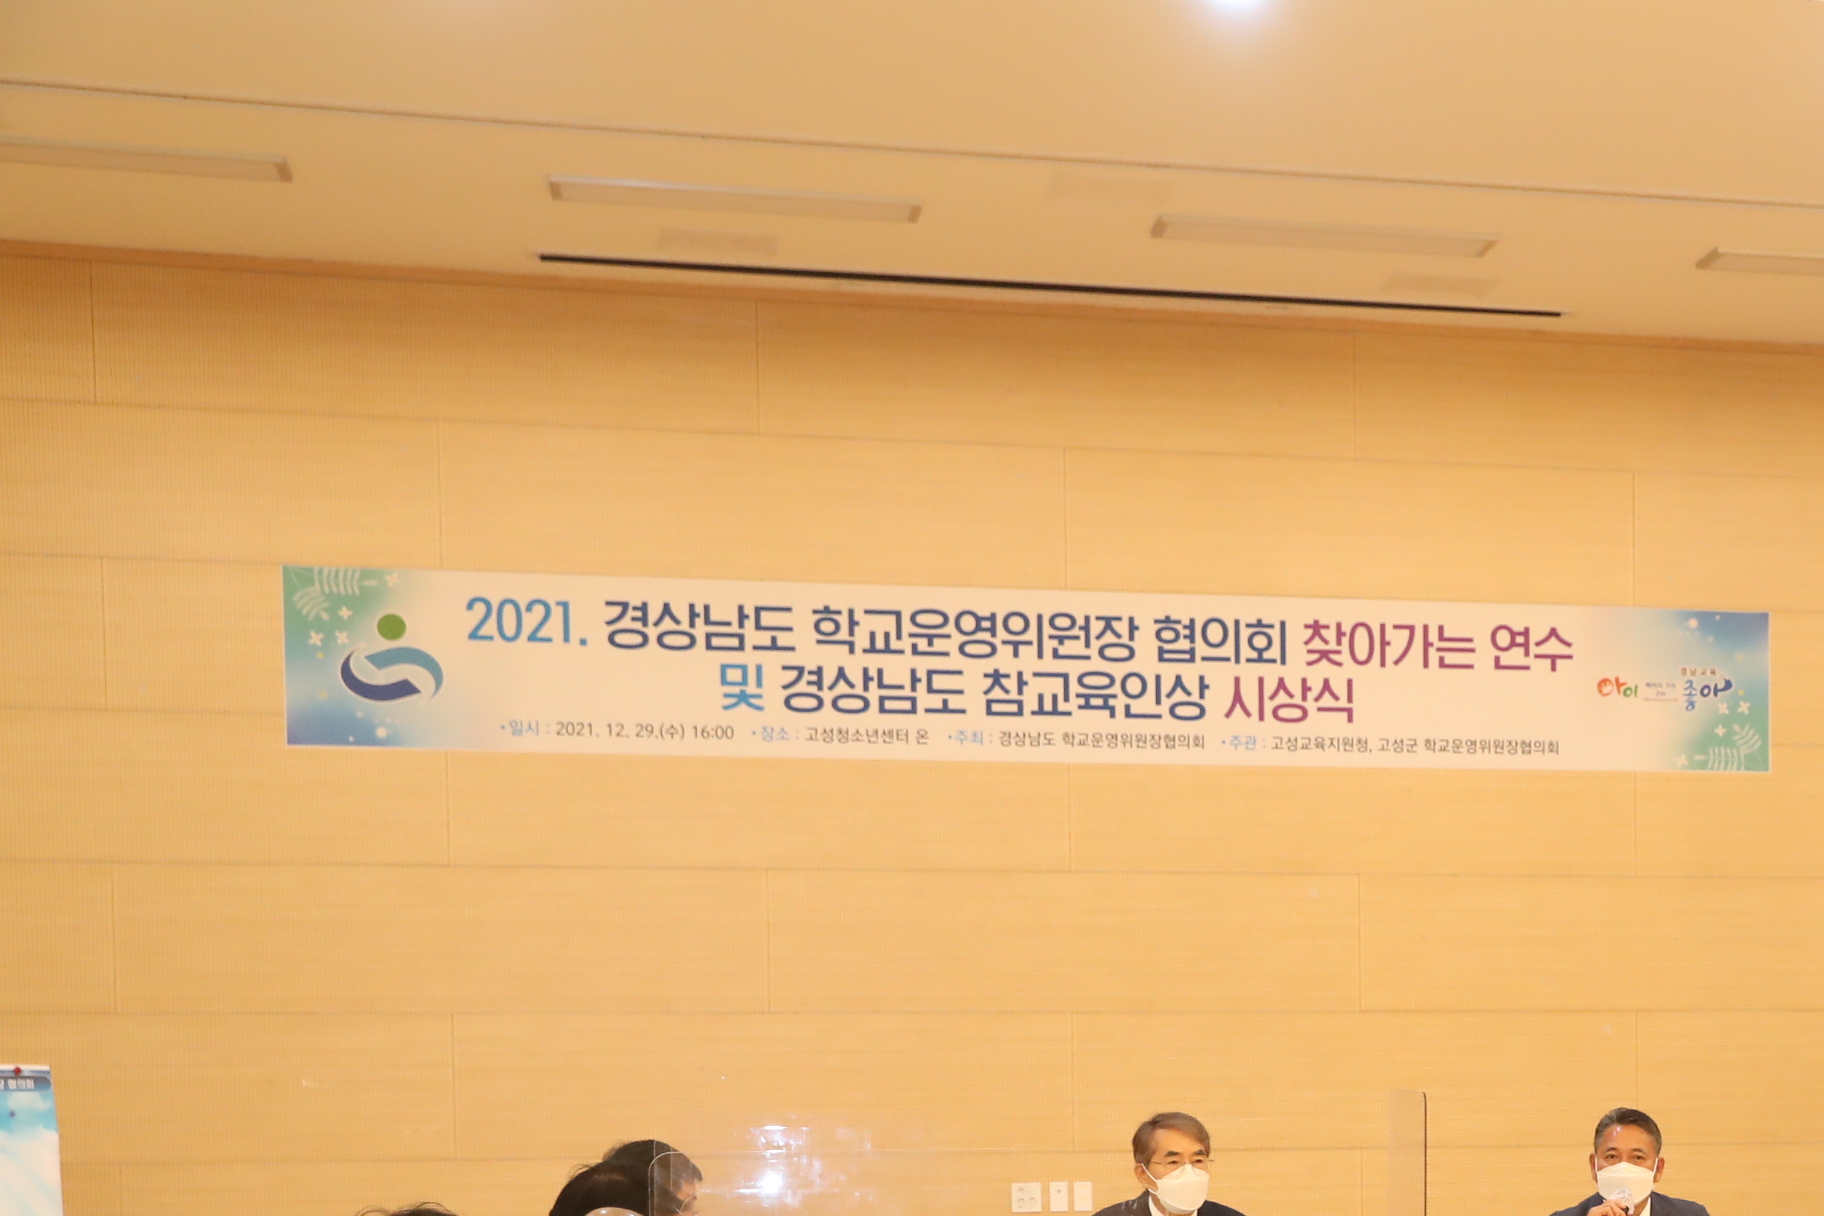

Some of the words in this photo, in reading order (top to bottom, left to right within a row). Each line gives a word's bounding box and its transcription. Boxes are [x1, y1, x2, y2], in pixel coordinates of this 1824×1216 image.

[465, 596, 588, 647] 2021.
[604, 600, 797, 652] 경상남도
[812, 605, 1140, 663] 학교운영위원장
[1154, 615, 1287, 666] 협의회
[1302, 619, 1476, 670] 찾아가는
[1490, 624, 1574, 673] 연수
[720, 663, 765, 712] 및
[781, 665, 967, 715] 경상남도
[983, 668, 1210, 723] 참교육인상
[1224, 675, 1354, 724] 시상식
[555, 721, 600, 738] 2021.
[692, 724, 735, 741] 16:00
[805, 727, 910, 745] 고성청소년센터
[915, 728, 929, 745] 온
[999, 730, 1057, 748] 경상남도
[1062, 731, 1205, 751] 학교운영위원장협의회
[1271, 735, 1373, 754] 고성교육지원청,
[1378, 737, 1419, 754] 고성군
[1424, 738, 1560, 757] 학교운영위원장협의회
